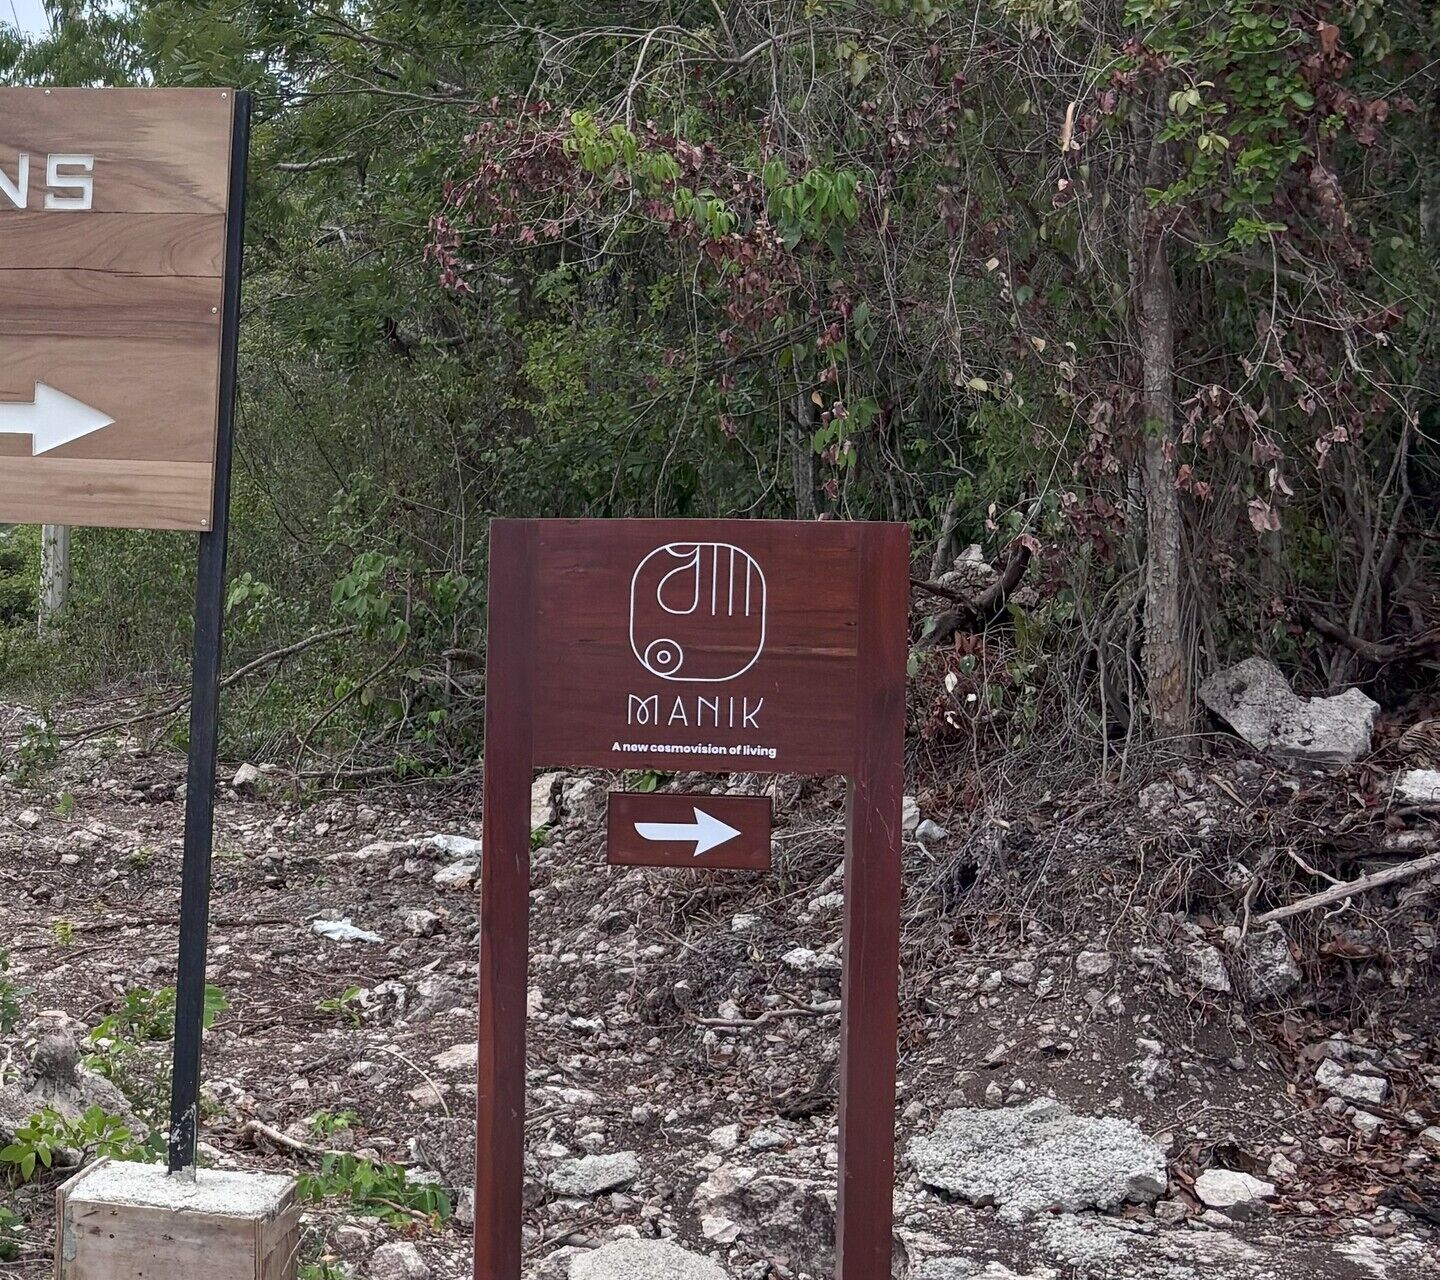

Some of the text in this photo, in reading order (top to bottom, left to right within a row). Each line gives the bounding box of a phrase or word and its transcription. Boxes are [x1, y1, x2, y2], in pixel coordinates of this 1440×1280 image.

[627, 694, 764, 729] MANIK
[611, 741, 777, 759] A new cosmovision of living
